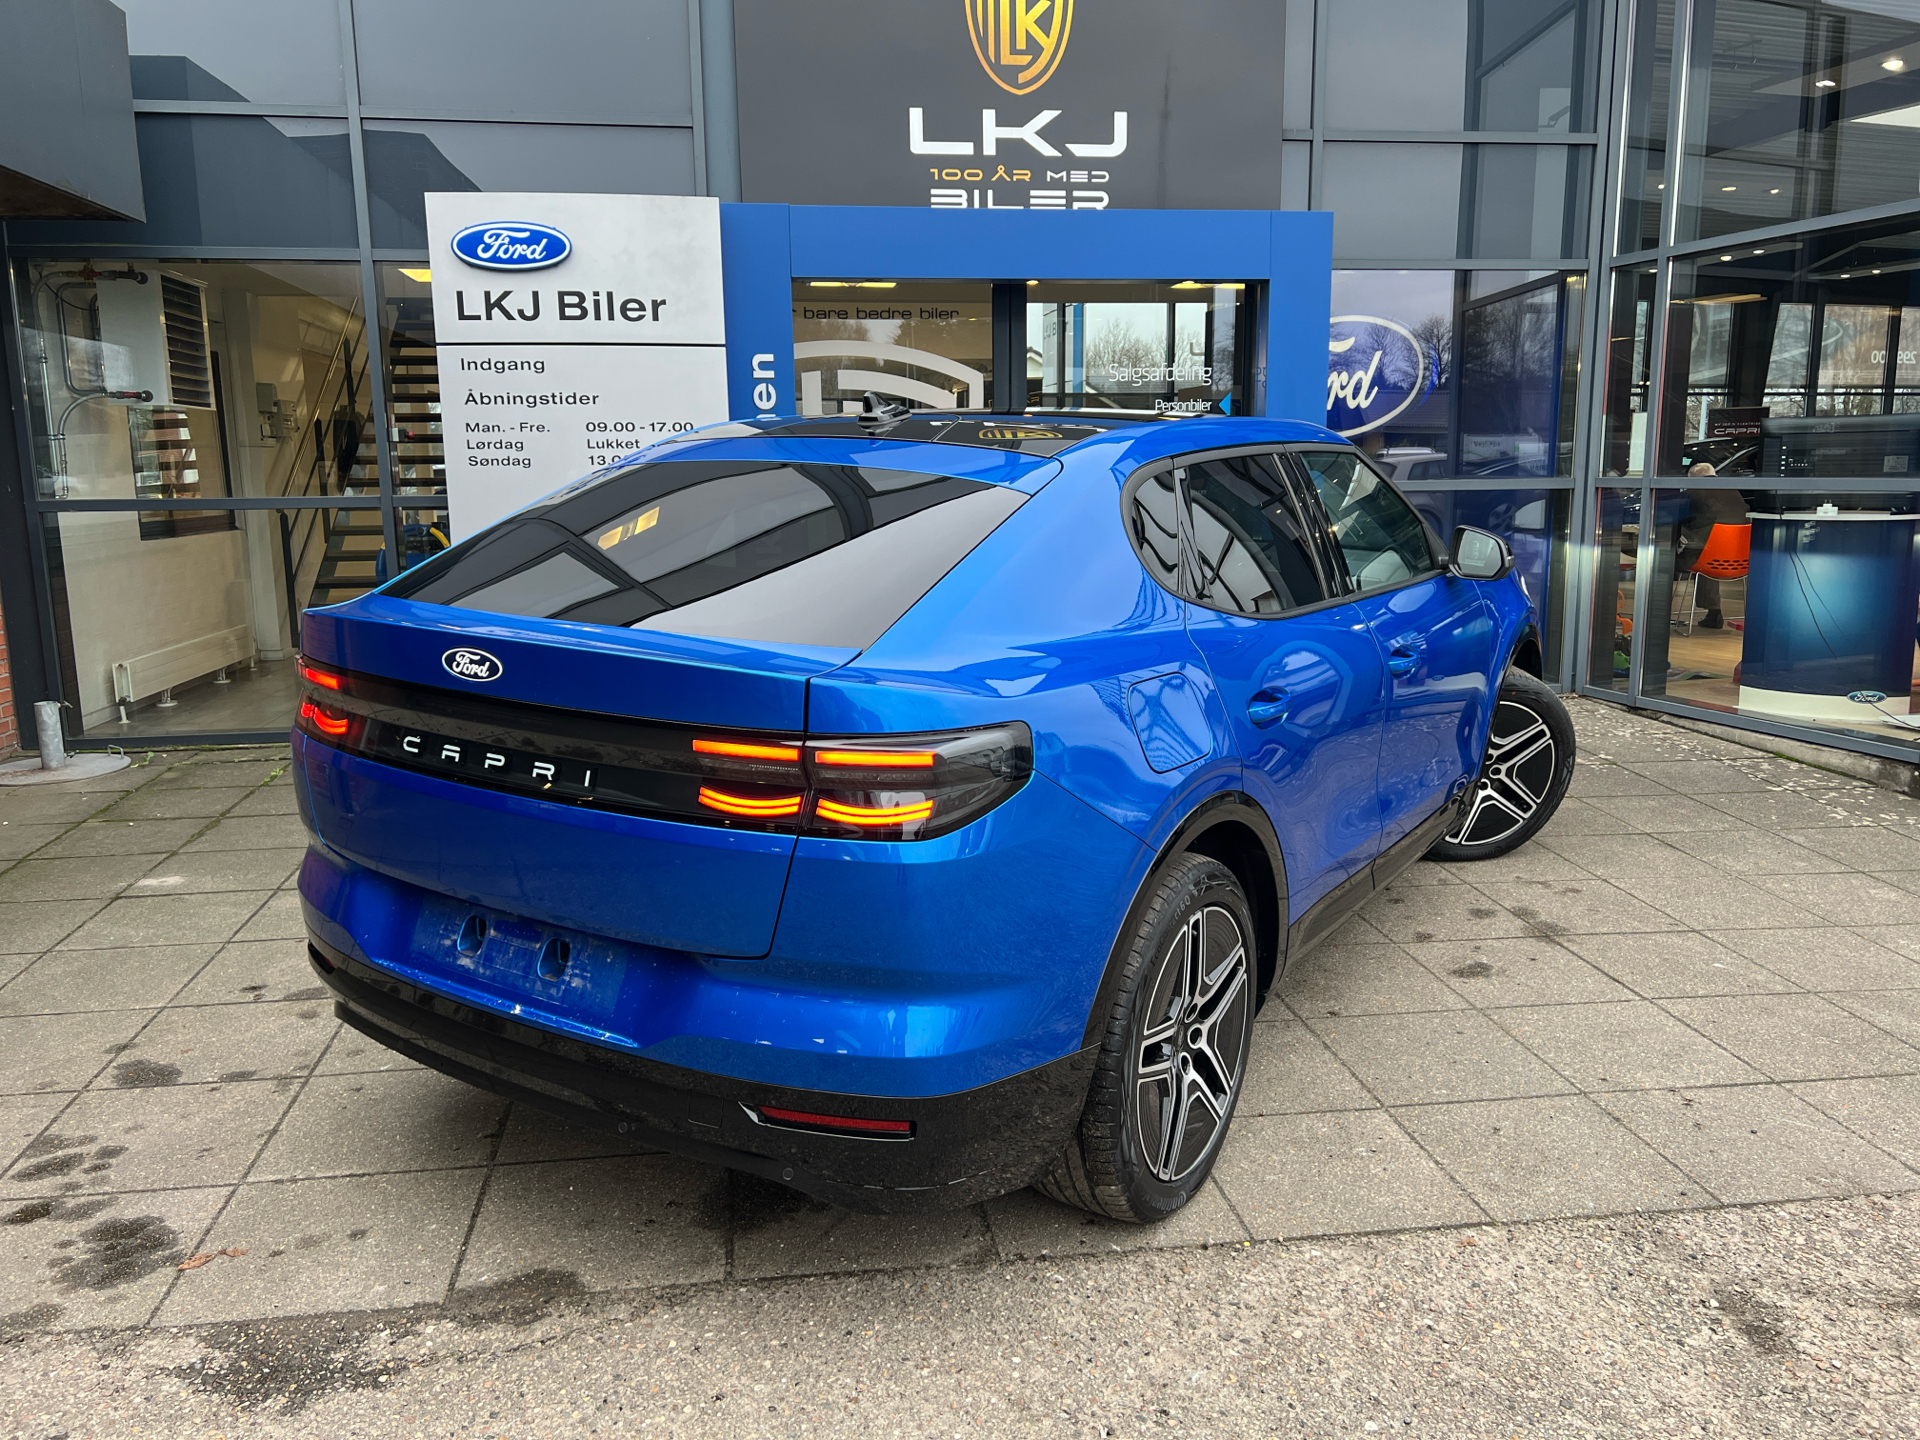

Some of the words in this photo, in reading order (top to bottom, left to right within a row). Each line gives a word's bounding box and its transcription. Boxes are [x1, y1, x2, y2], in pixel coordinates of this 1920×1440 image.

[909, 107, 1128, 158] LKJ
[930, 168, 984, 181] 100
[991, 165, 1032, 182] ÅR
[1047, 170, 1110, 183] MED
[930, 189, 1110, 210] BILER
[476, 229, 548, 260] Ford
[456, 290, 541, 322] LKJ
[557, 290, 667, 323] Biler
[803, 307, 849, 320] bare
[856, 307, 912, 320] bedre
[920, 307, 959, 320] biler
[460, 357, 546, 374] Indgang
[1109, 363, 1212, 386] Salgsafdeling
[464, 388, 600, 409] Åbningstider
[1155, 399, 1212, 412] Personbiler
[465, 422, 506, 433] Man.
[519, 422, 551, 433] Fre.
[585, 421, 636, 433] 09.00
[649, 422, 694, 432] 17.00
[466, 438, 525, 452] Lørdag
[586, 438, 641, 450] Lukket
[468, 455, 532, 469] Søndag
[588, 455, 624, 466] 13.0
[452, 651, 490, 678] Ford
[403, 735, 591, 787] CAPRI
